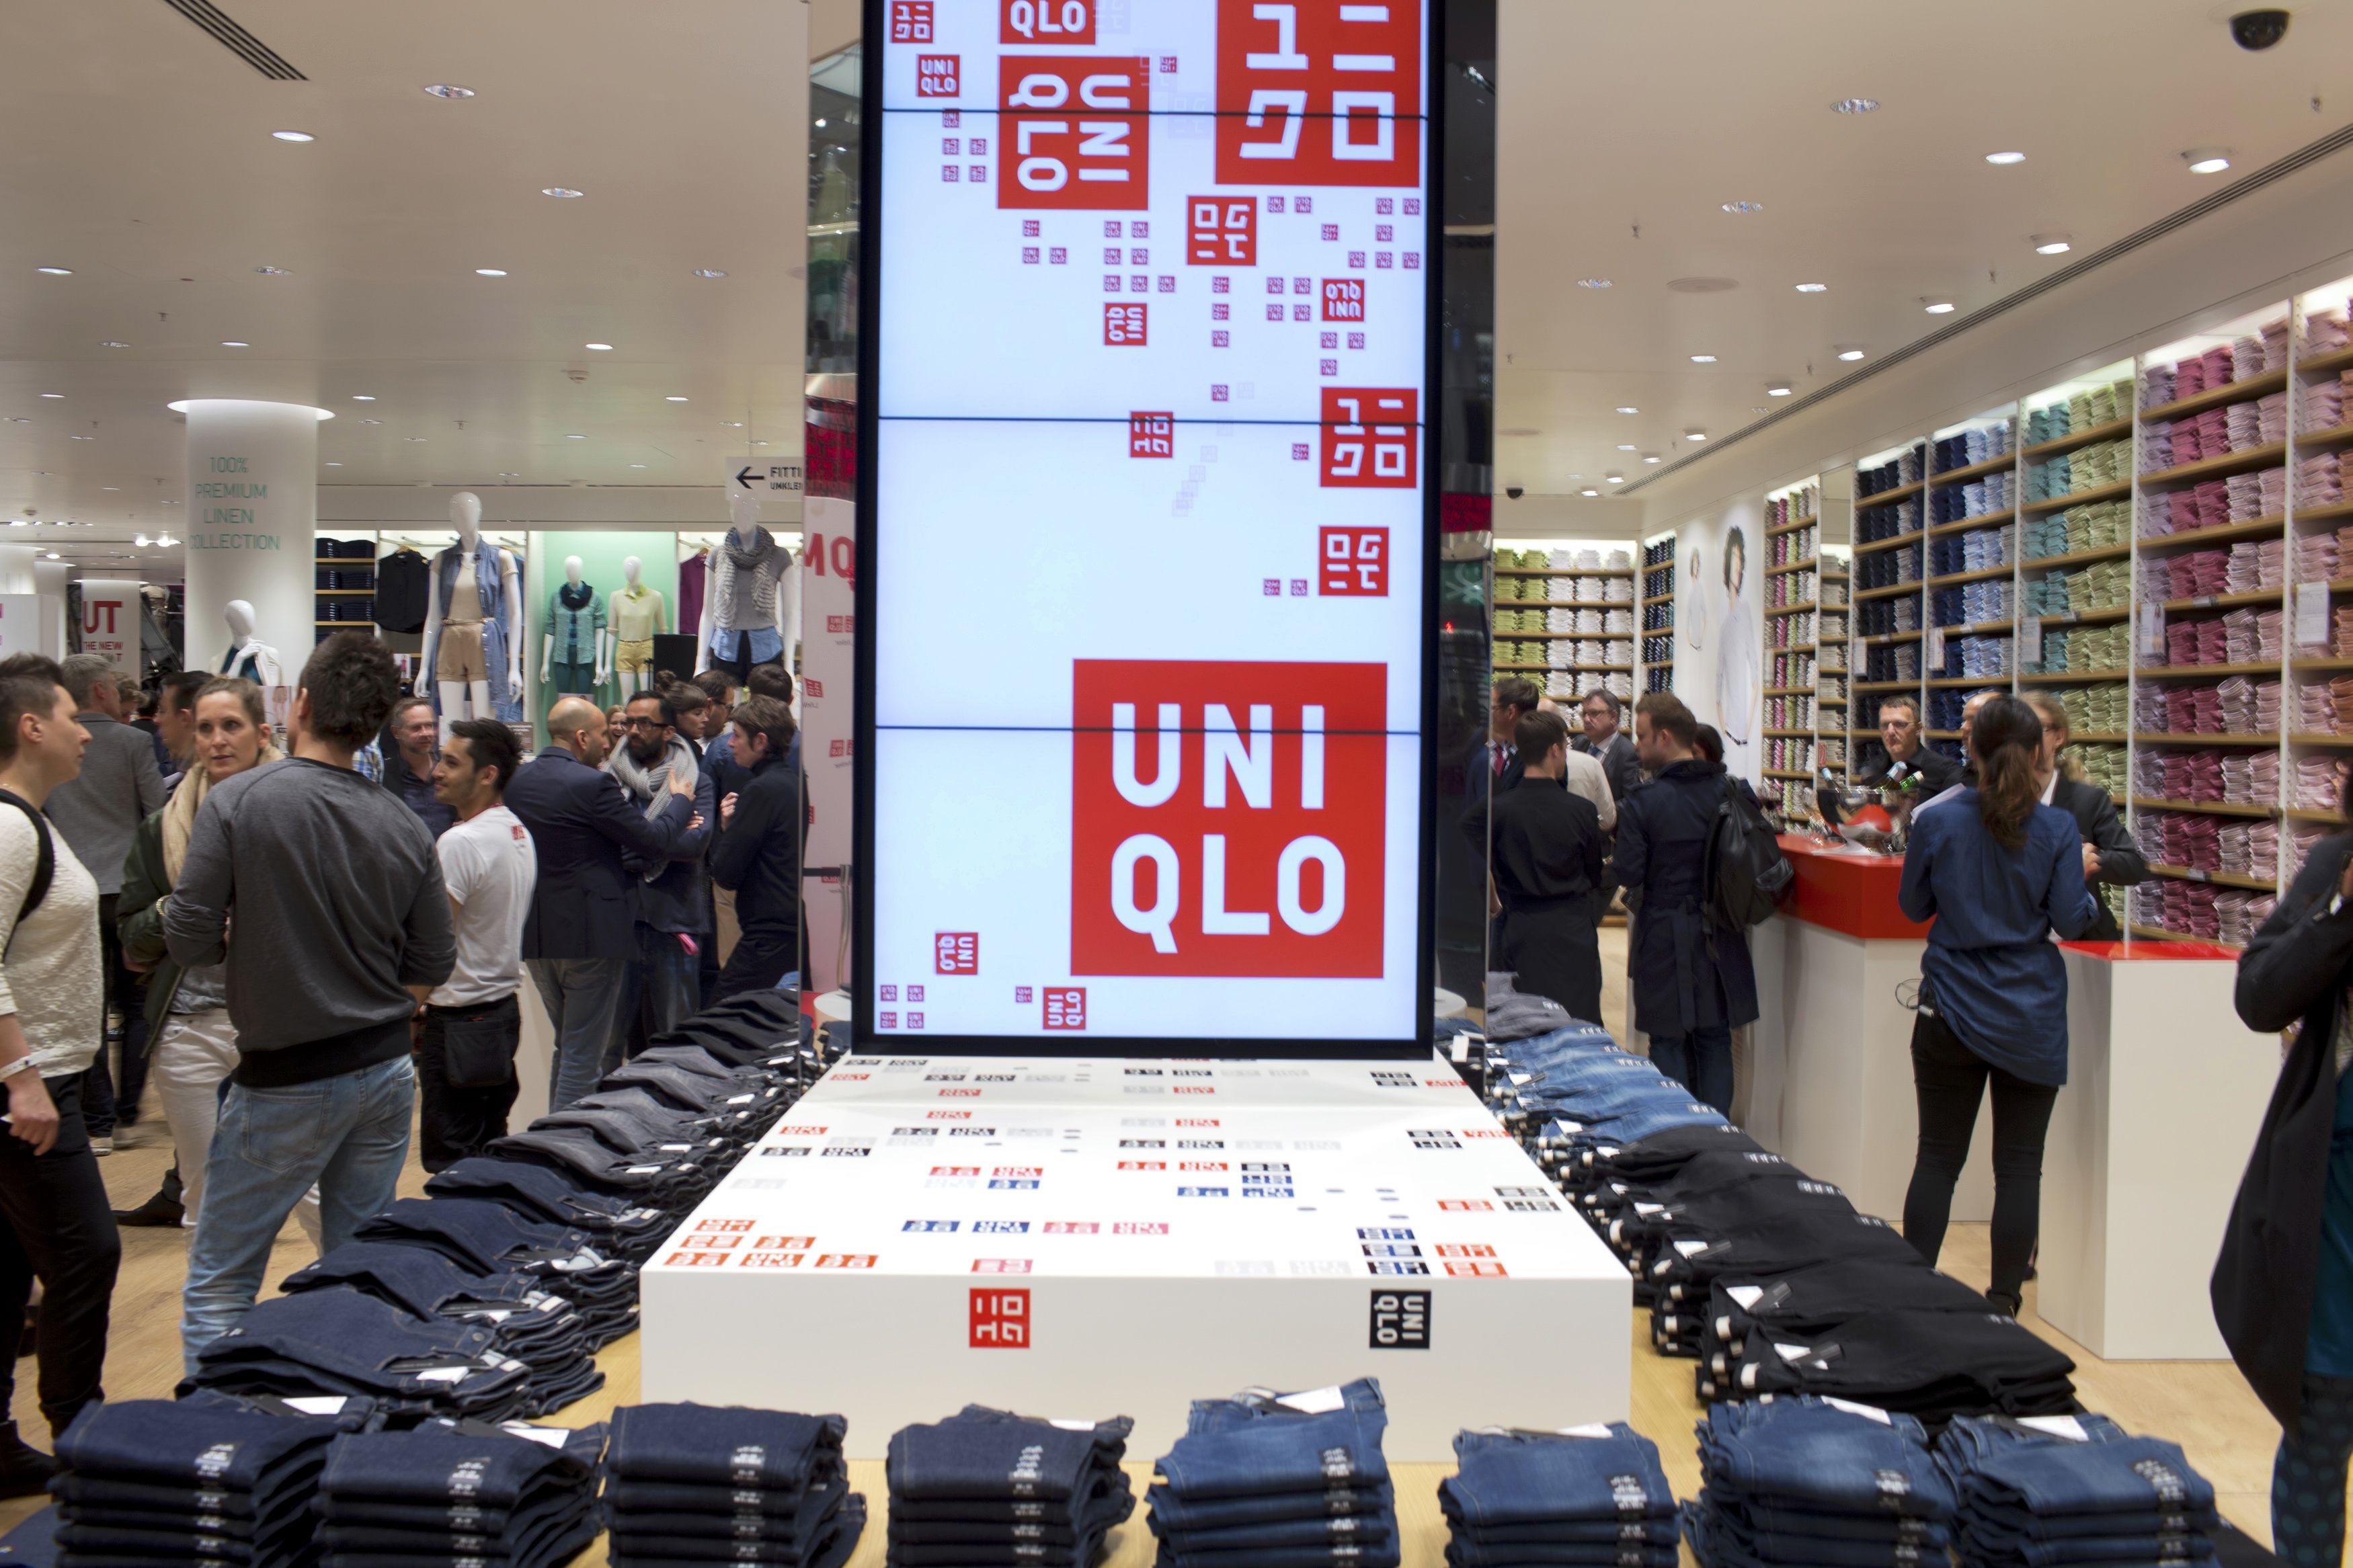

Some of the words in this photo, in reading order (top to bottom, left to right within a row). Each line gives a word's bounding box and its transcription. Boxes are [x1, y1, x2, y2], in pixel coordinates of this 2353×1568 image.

[1010, 1, 1086, 38] QLO
[920, 59, 954, 76] UNI
[920, 76, 957, 95] QLO
[1008, 73, 1069, 191] QLO
[1079, 75, 1131, 182] UNI
[1326, 281, 1361, 300] QLO
[1106, 306, 1126, 342] QLO
[1126, 306, 1144, 339] UNI
[1328, 301, 1361, 318] UNI
[210, 456, 249, 473] 100%
[195, 483, 268, 499] PREMIUM
[204, 508, 254, 524] LINEN
[189, 534, 280, 550] COLLECTION
[83, 600, 122, 634] UT
[83, 641, 97, 651] THE
[99, 641, 124, 651] NEW
[1112, 702, 1325, 809] UNI
[1111, 833, 1346, 954] QLO
[938, 935, 956, 971] QLO
[957, 936, 973, 968] UNI
[1048, 993, 1064, 1026] UNI
[1065, 991, 1083, 1027] QLO
[1373, 1294, 1399, 1344] QLO
[1401, 1294, 1425, 1340] UNI
